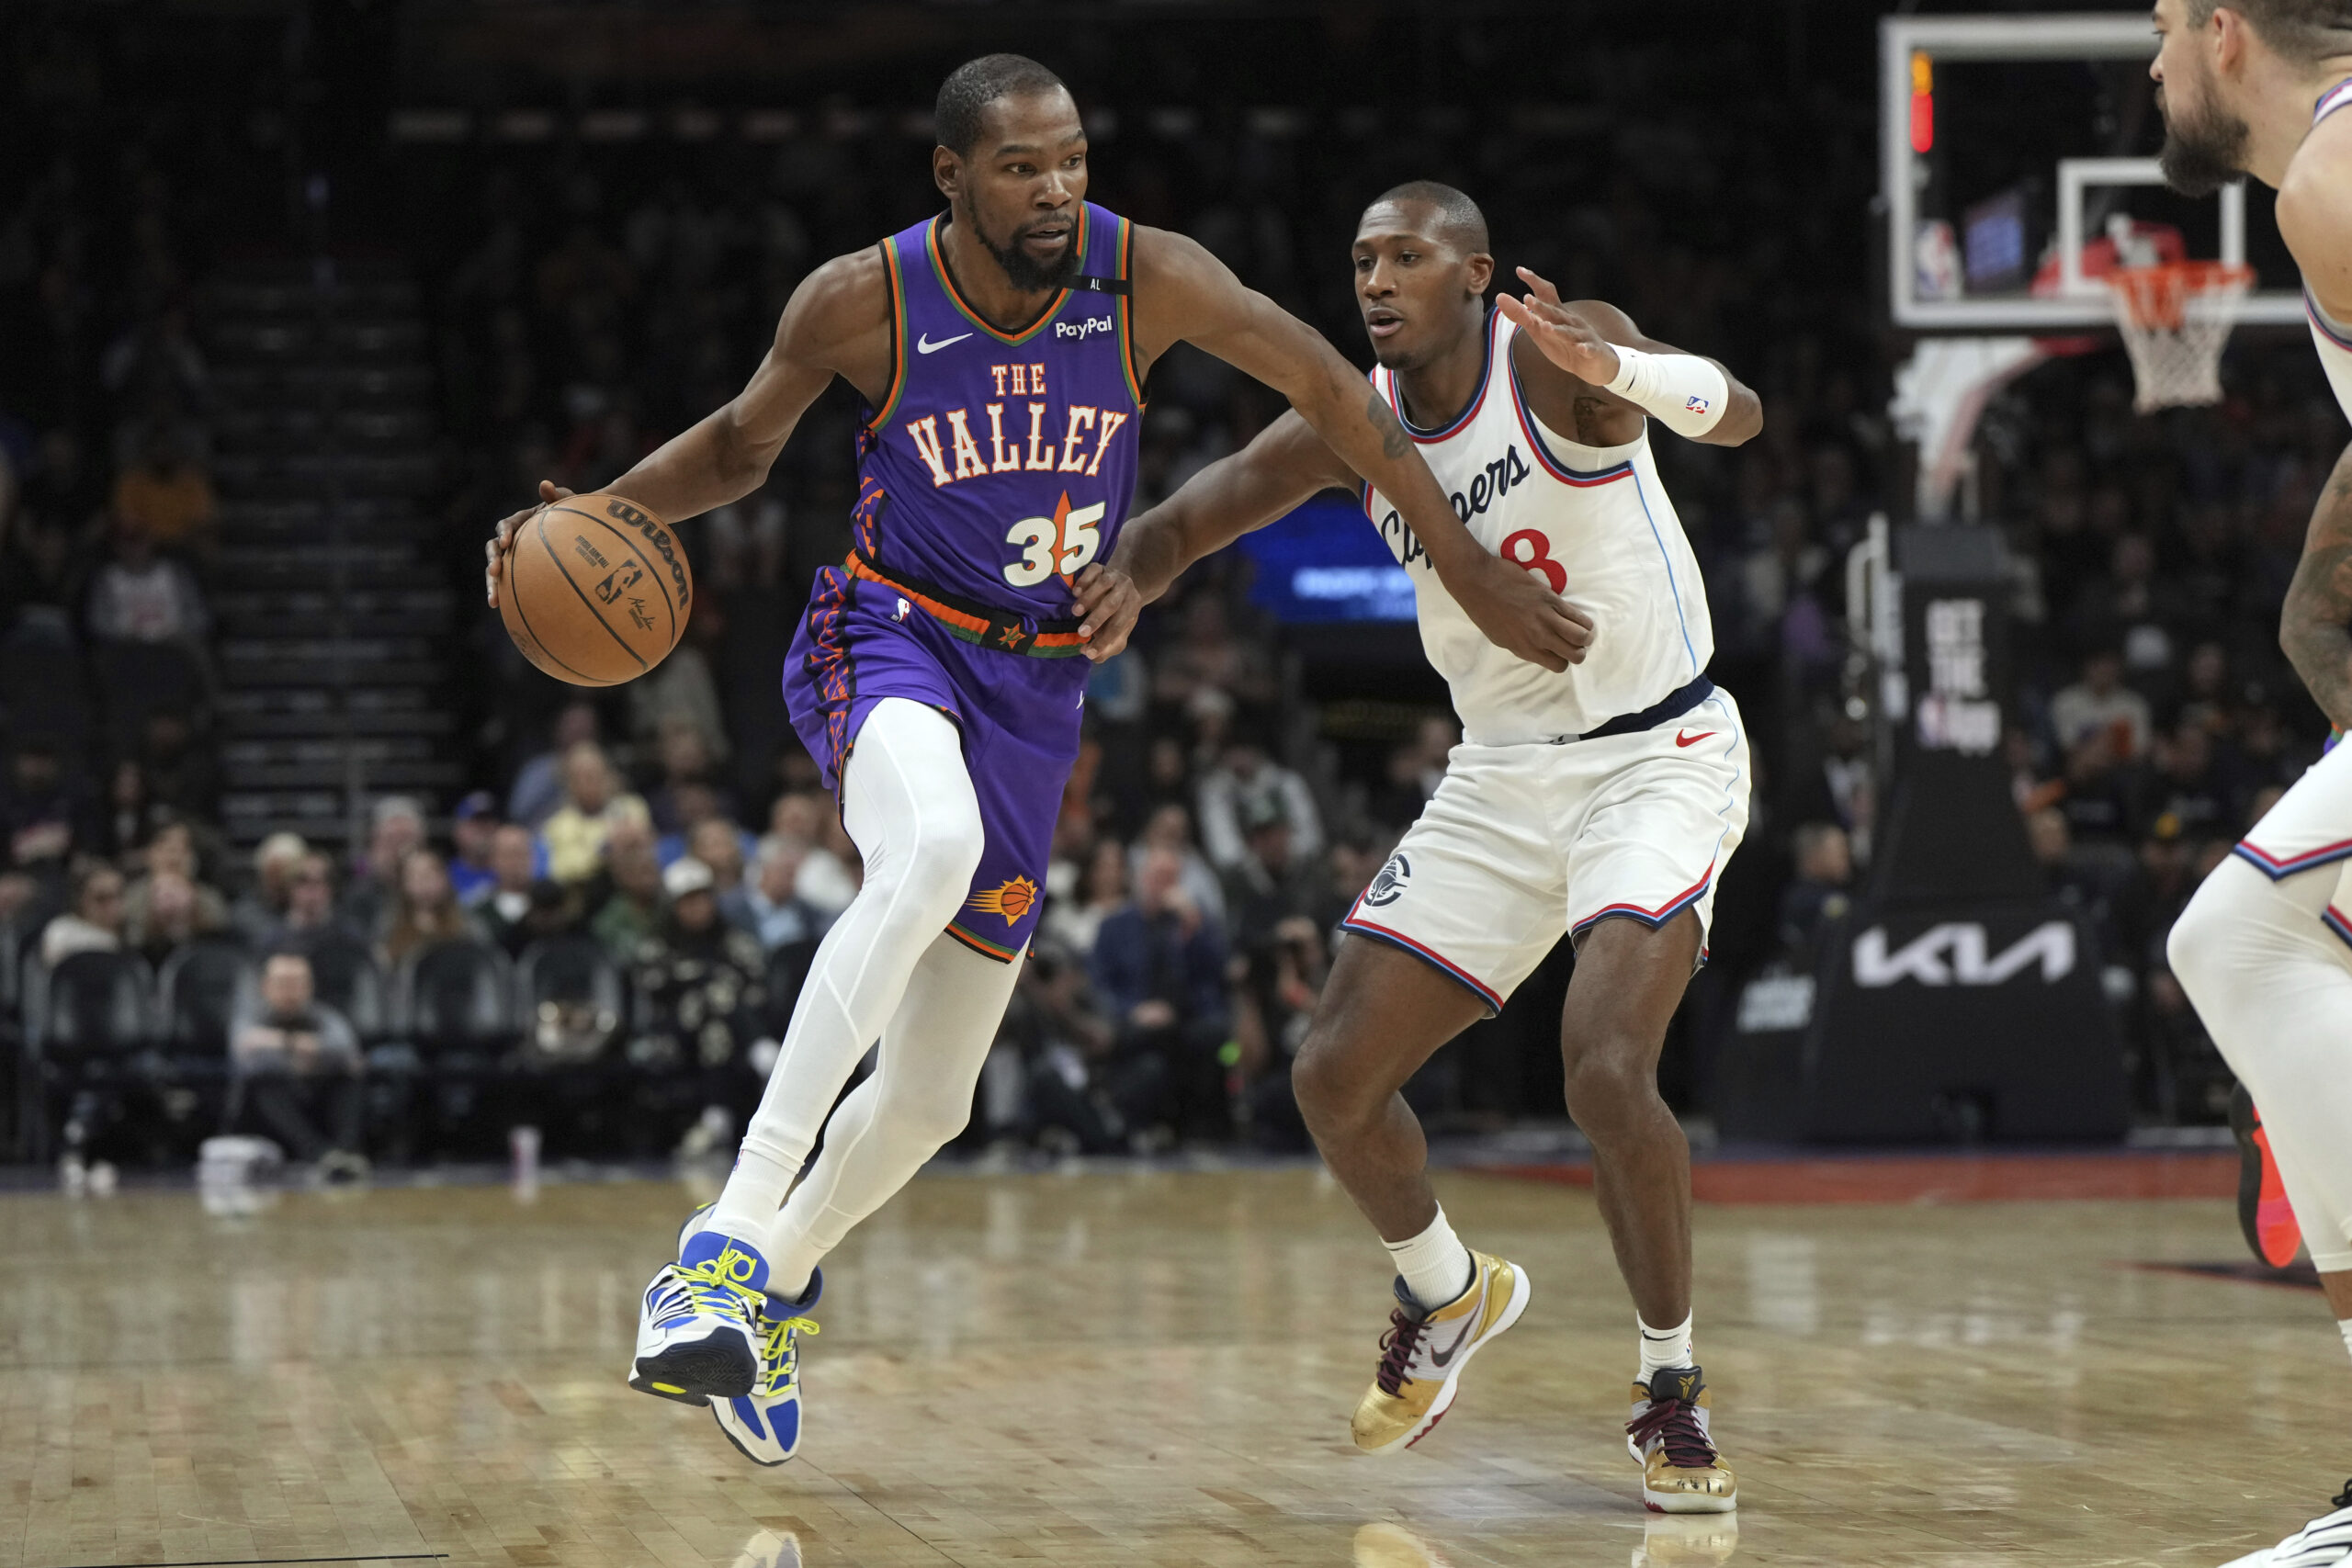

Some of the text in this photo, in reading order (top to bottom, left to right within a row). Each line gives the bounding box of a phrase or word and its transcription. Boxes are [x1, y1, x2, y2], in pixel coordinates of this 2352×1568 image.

[1091, 278, 1101, 290] AL
[1055, 315, 1113, 340] PayPal
[991, 364, 1046, 395] THE
[906, 401, 1127, 488] VALLEY
[606, 499, 689, 610] Wilson
[1003, 502, 1105, 587] 35
[1500, 528, 1567, 595] 8
